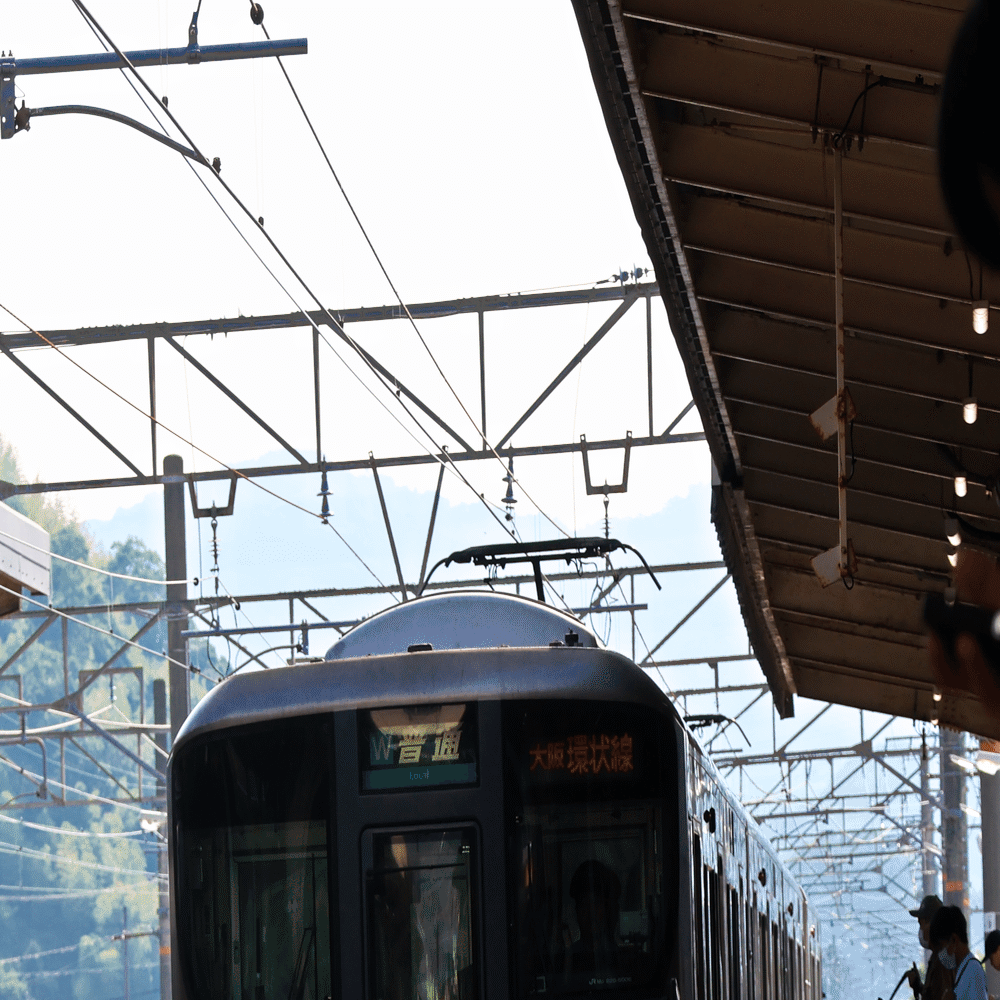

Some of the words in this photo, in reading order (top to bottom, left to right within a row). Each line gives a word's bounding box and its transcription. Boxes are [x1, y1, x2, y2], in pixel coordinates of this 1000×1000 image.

[529, 732, 634, 774] 大阪環状線
